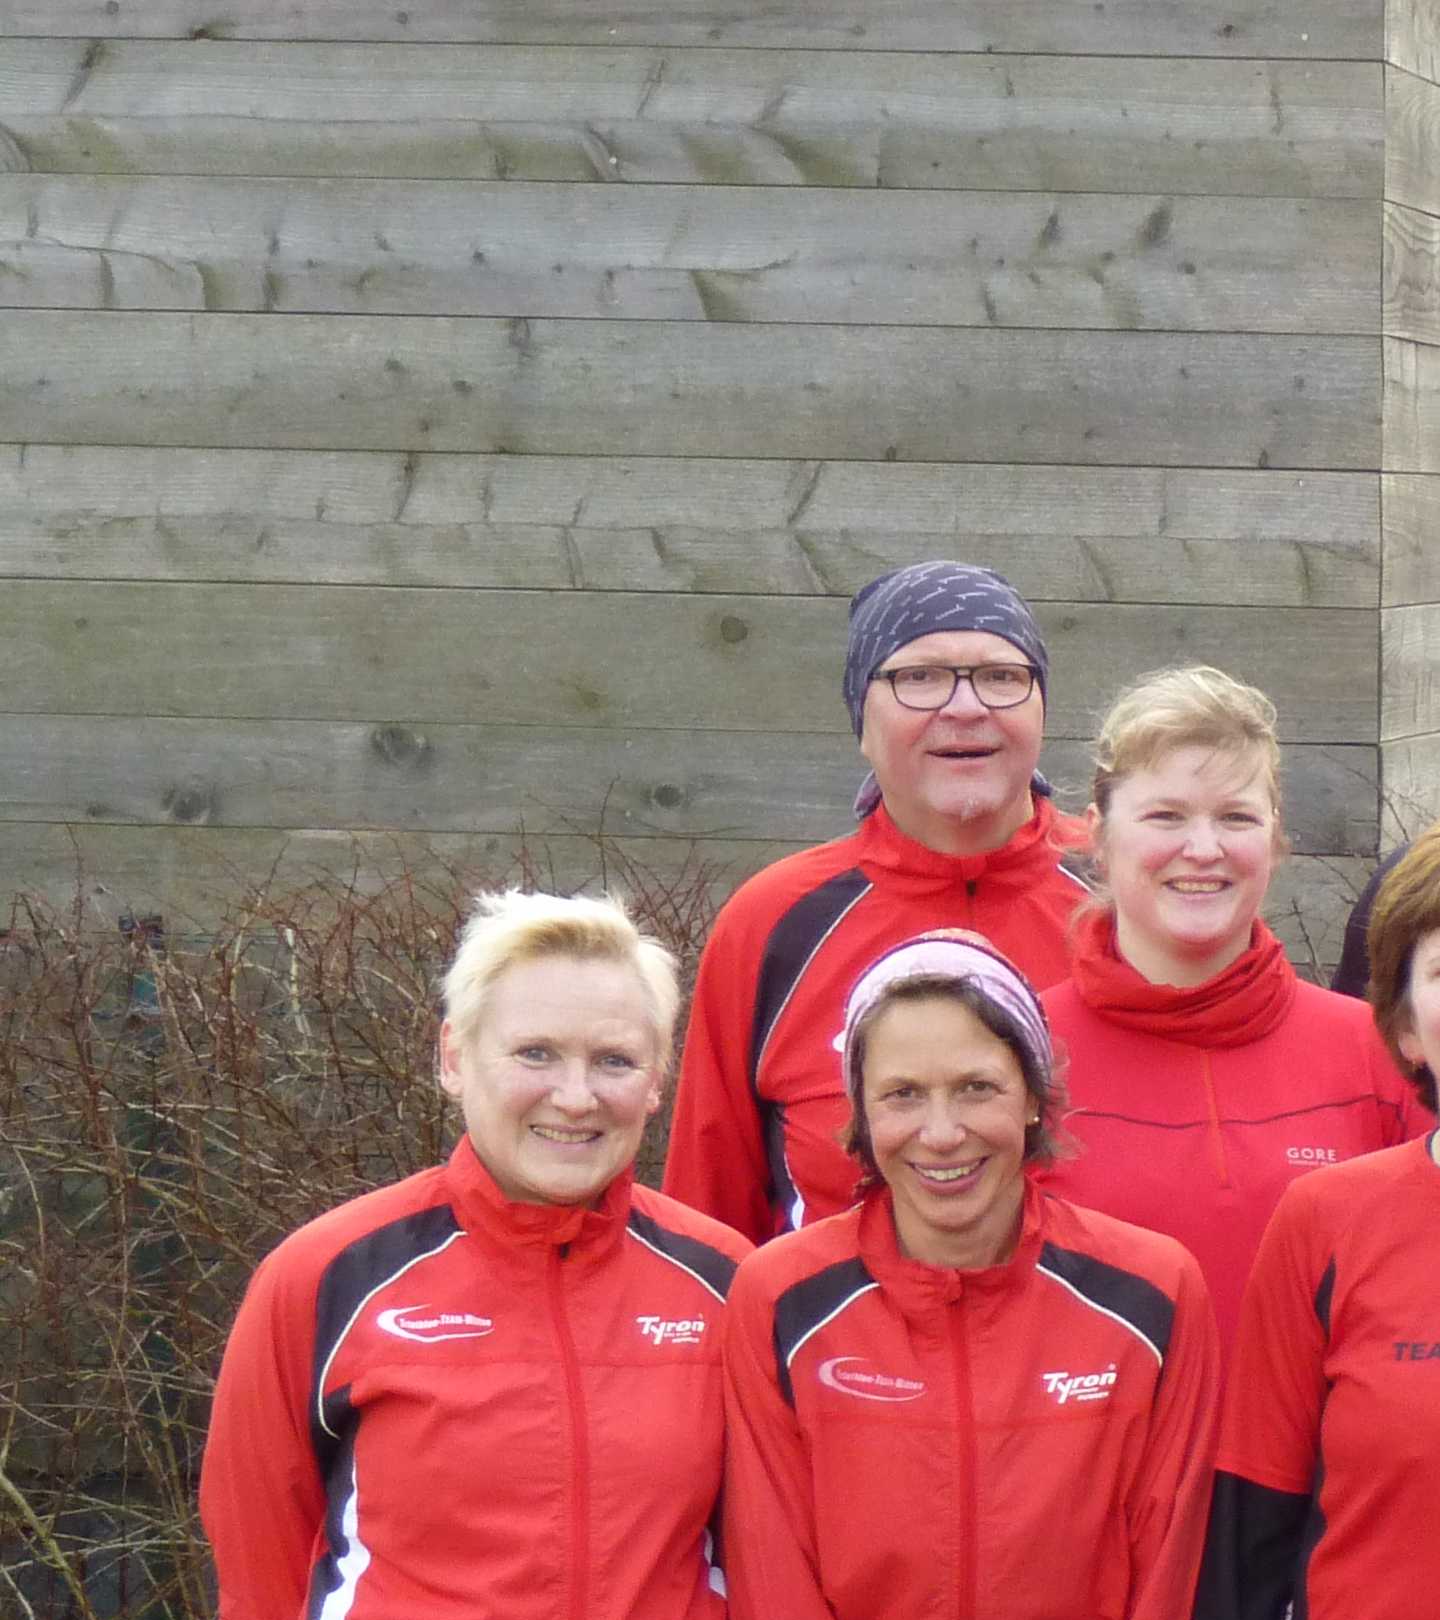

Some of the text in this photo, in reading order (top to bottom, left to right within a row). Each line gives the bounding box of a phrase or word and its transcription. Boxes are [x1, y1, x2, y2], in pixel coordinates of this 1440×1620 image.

[1286, 1147, 1337, 1161] GORE
[636, 1316, 705, 1345] Tyron
[1043, 1372, 1118, 1405] Tyron
